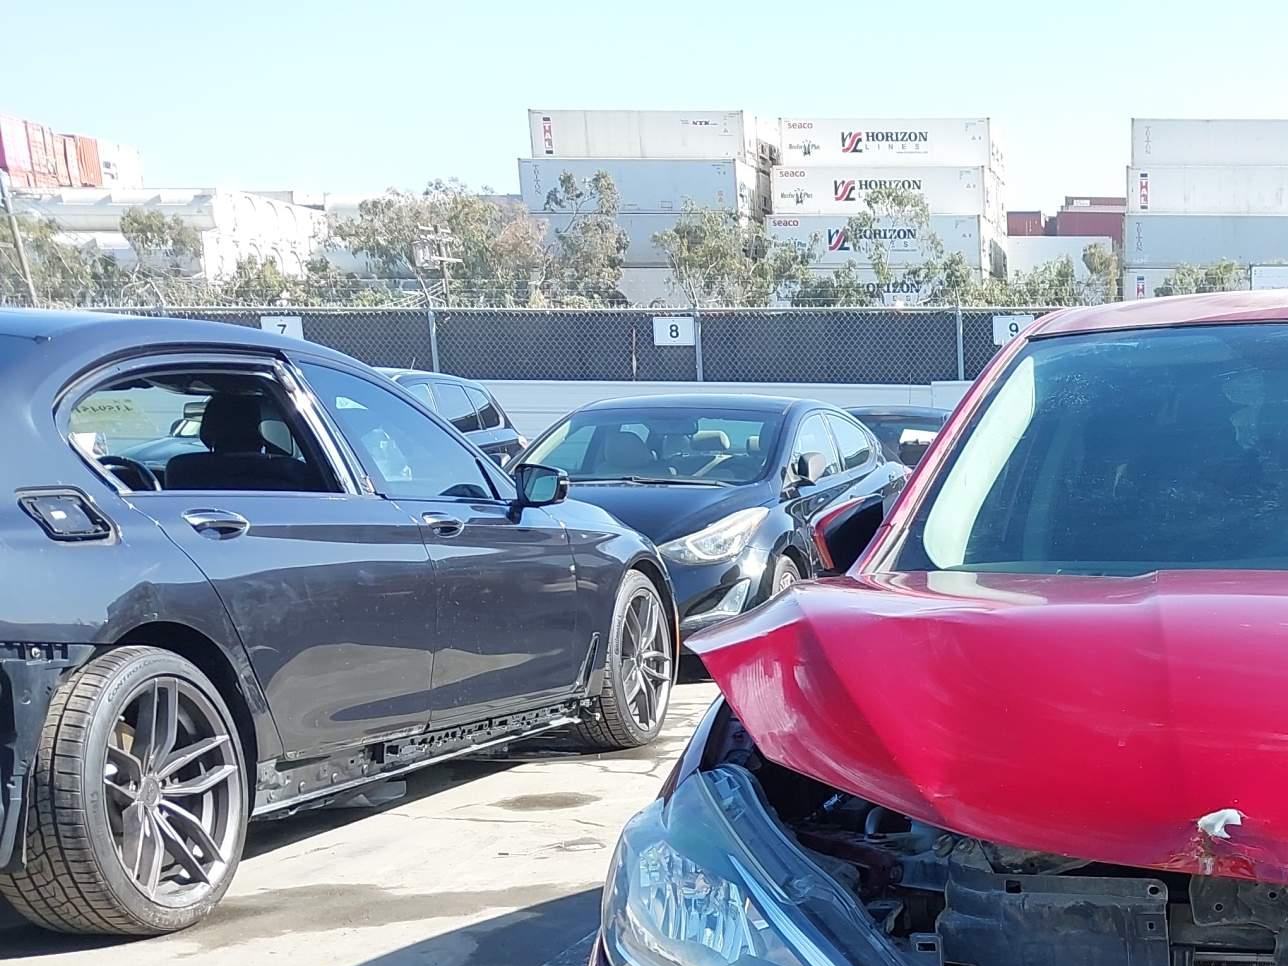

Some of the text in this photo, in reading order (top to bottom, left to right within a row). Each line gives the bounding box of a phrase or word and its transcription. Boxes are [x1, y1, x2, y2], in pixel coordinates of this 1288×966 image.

[787, 121, 813, 129] seaco
[865, 131, 928, 142] HORIZON
[779, 170, 805, 178] seaco
[858, 180, 922, 190] HORIZON
[772, 219, 799, 227] seaco
[277, 324, 287, 334] 7
[669, 324, 679, 338] 8
[1009, 322, 1019, 337] 9
